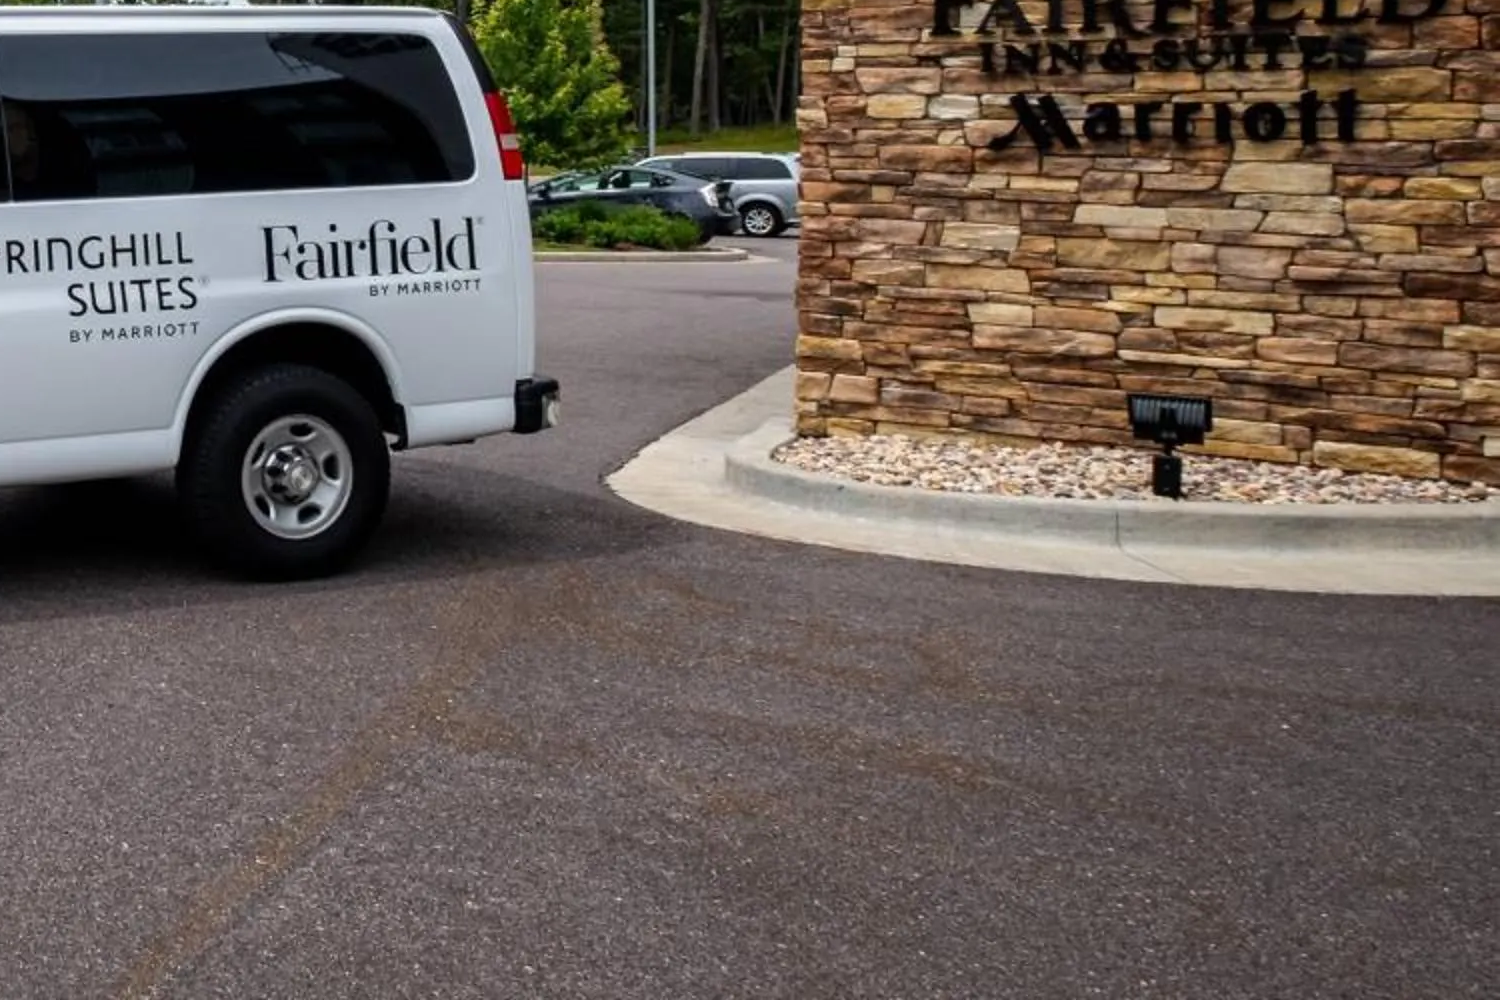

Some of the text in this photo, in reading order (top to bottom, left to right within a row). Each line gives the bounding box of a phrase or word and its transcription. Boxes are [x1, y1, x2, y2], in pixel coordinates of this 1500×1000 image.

[980, 32, 1368, 76] INN & SUITES
[989, 88, 1358, 152] Marriott
[260, 217, 481, 283] Fairfield
[67, 276, 198, 317] SUITES
[369, 278, 482, 298] BY MARRIOTT
[69, 321, 200, 343] BY MARRIOTT
